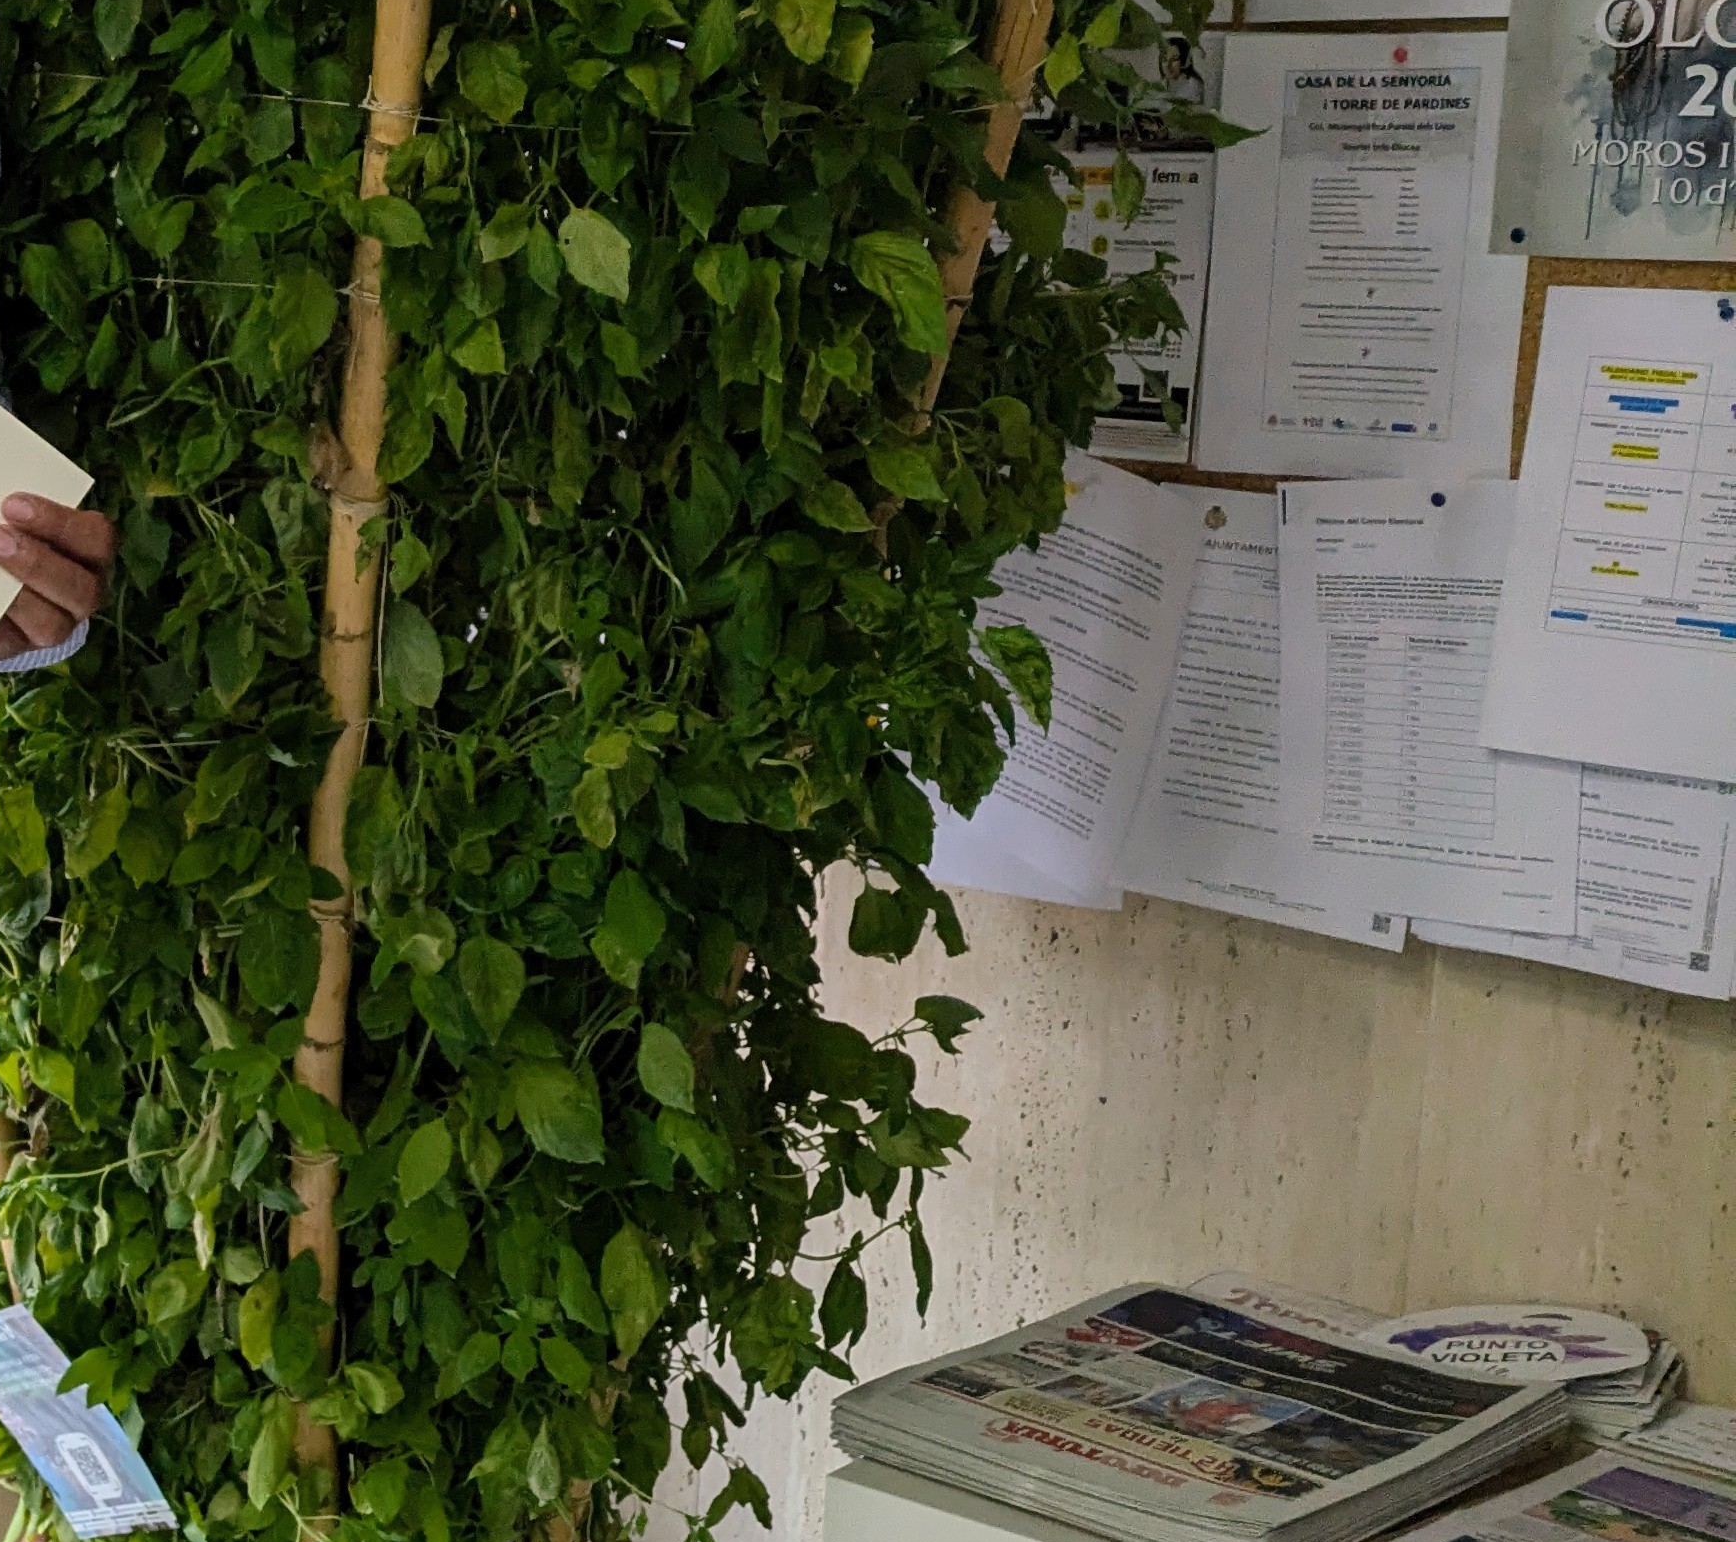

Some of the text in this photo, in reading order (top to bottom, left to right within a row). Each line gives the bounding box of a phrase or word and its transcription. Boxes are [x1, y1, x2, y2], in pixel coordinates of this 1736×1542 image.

[1295, 74, 1451, 88] CASA DE LA SENYORIA
[1331, 99, 1377, 111] TORRE
[1382, 99, 1400, 109] DE
[1404, 97, 1471, 110] PARDINES
[1573, 139, 1730, 168] MOROS I
[1652, 177, 1693, 204] 10
[1445, 1339, 1549, 1350] PUNTO
[1429, 1351, 1558, 1363] VIOLETA
